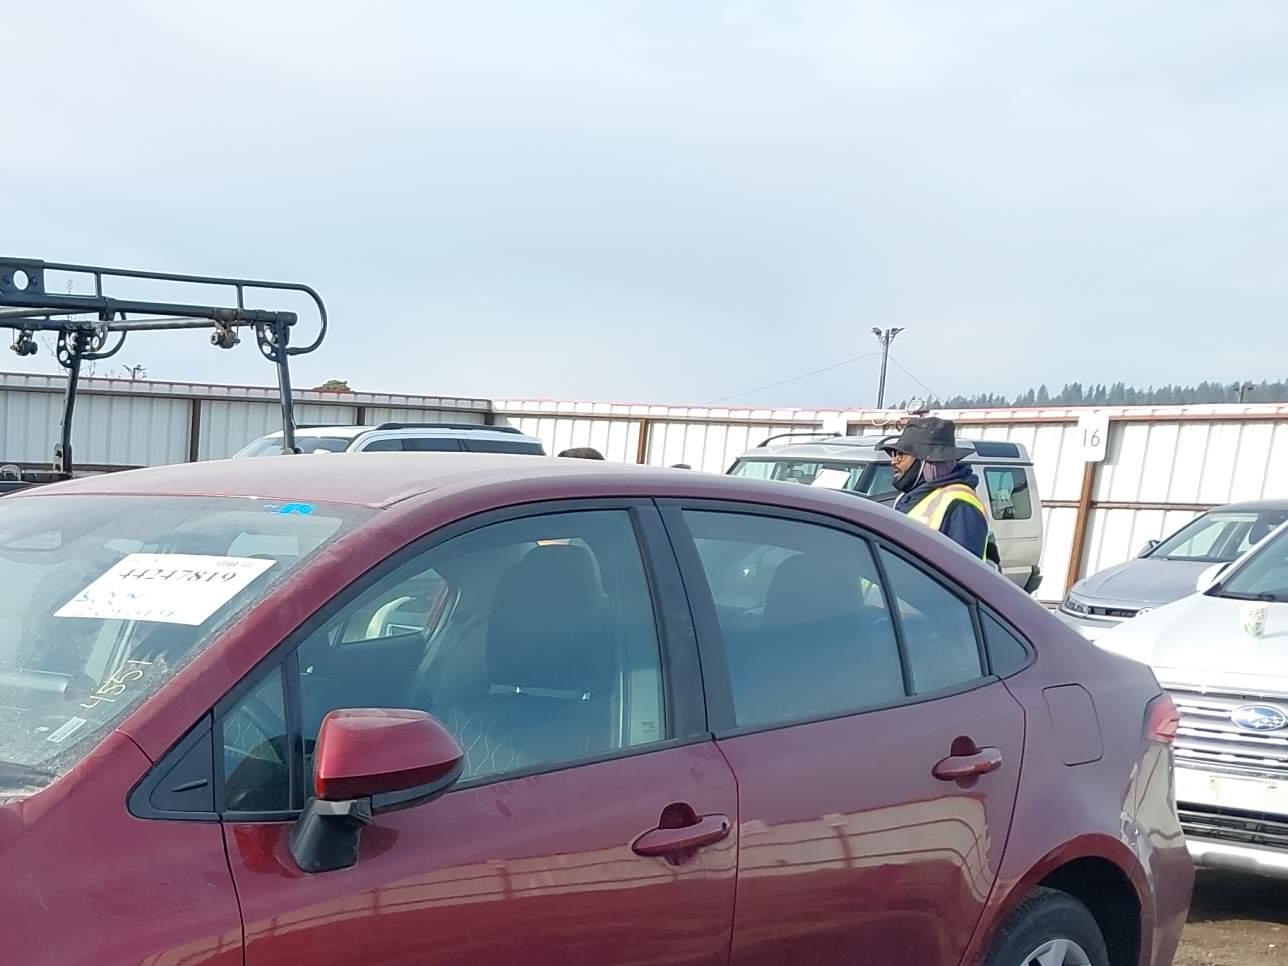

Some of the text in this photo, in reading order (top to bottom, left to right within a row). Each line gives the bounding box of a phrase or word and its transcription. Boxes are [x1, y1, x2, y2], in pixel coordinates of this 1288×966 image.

[1083, 428, 1100, 448] 16
[119, 567, 238, 583] 44247819
[79, 659, 153, 709] 4551
